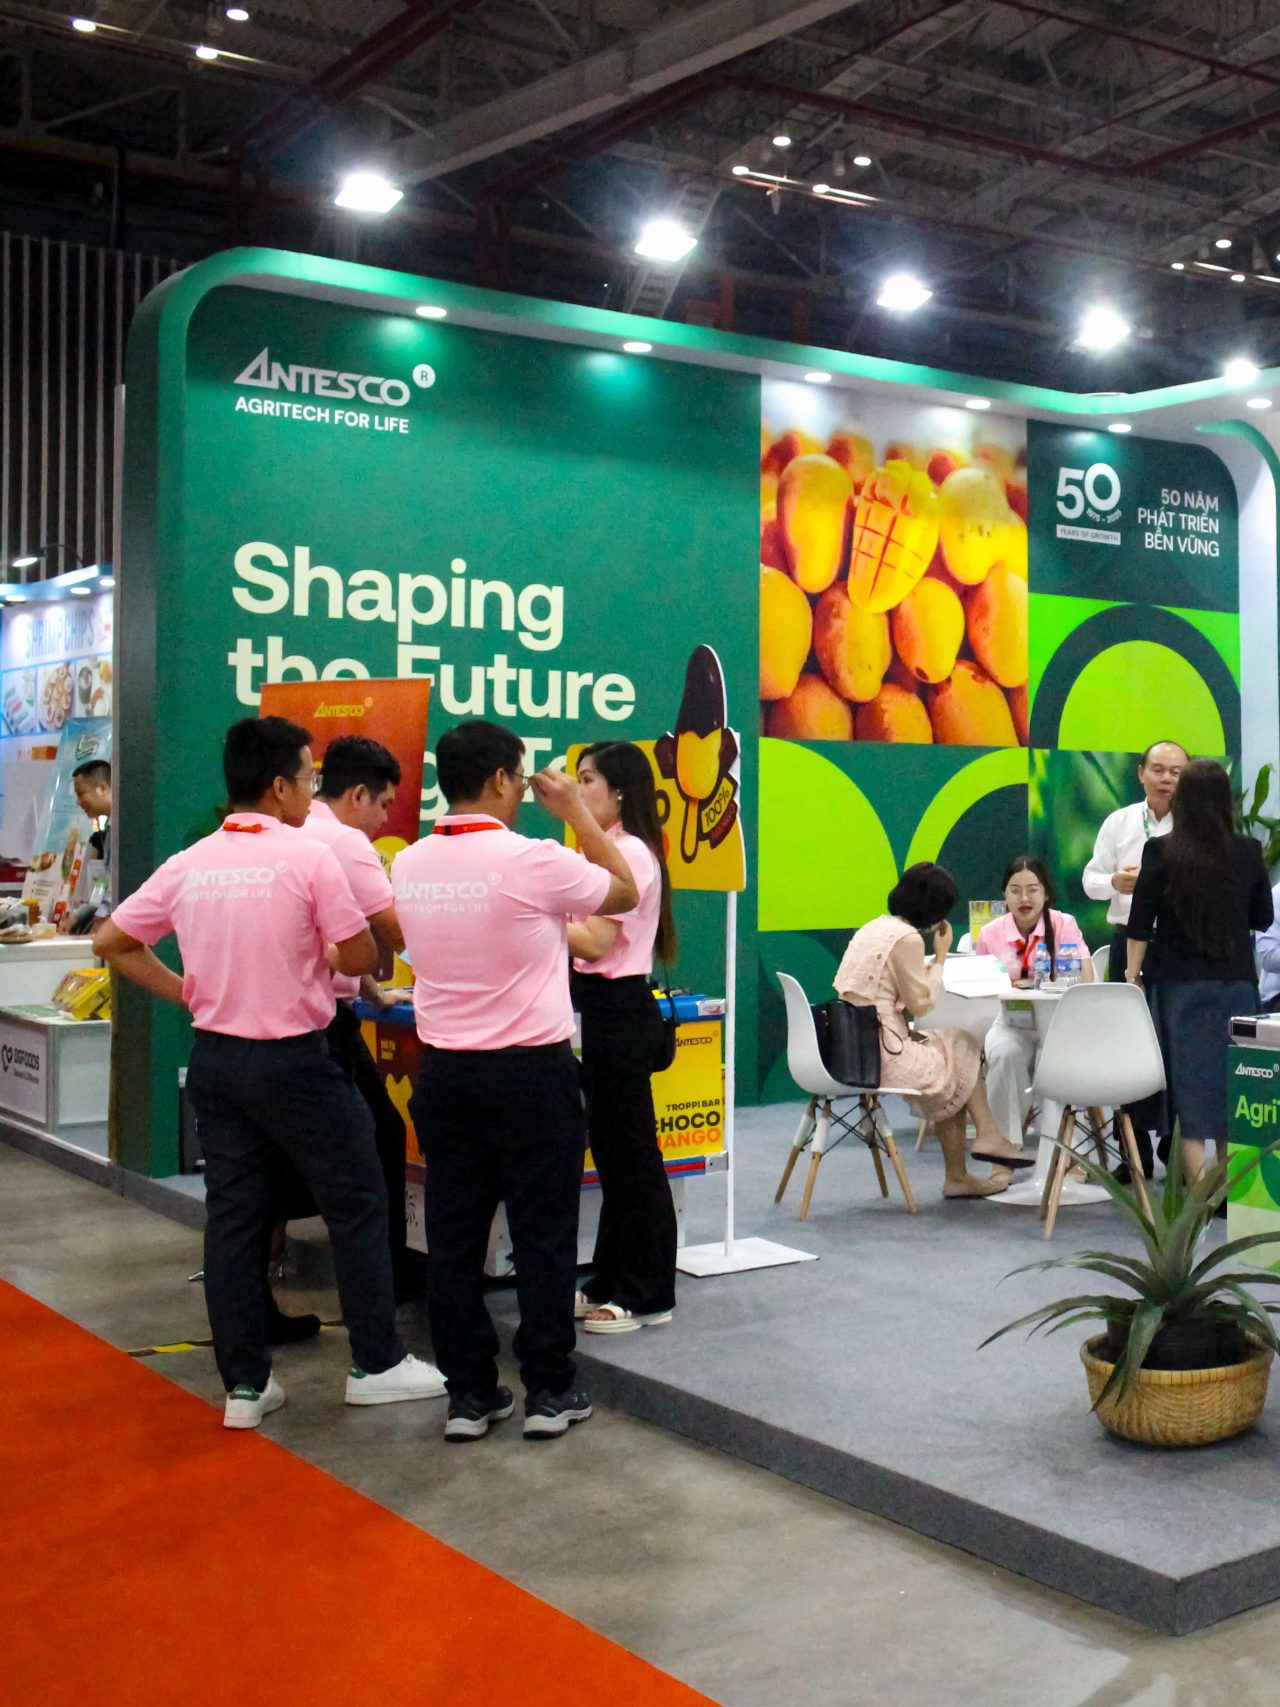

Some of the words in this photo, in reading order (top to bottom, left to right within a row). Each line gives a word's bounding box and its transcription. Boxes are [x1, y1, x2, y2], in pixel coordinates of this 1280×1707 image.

[233, 347, 411, 407] ANTESCO
[235, 396, 330, 424] AGRITECH
[334, 409, 370, 429] FOR
[374, 415, 409, 434] LIFE
[1056, 462, 1121, 519] 50
[1161, 488, 1181, 506] 50
[1184, 490, 1219, 512] NĂM
[1137, 506, 1176, 529] PHÁT
[1180, 505, 1220, 534] TRIỂN
[1144, 525, 1174, 551] BỀN
[1178, 534, 1220, 557] VŨNG
[232, 541, 565, 652] Shaping
[397, 644, 637, 722] Future
[314, 701, 365, 718] ANTESCO
[705, 786, 730, 827] 100%
[396, 874, 489, 899] ANTESCO
[1235, 1062, 1274, 1079] ANTESCO
[665, 1101, 700, 1113] TROPPI
[702, 1098, 720, 1108] BAR
[655, 1111, 721, 1133] HOCO
